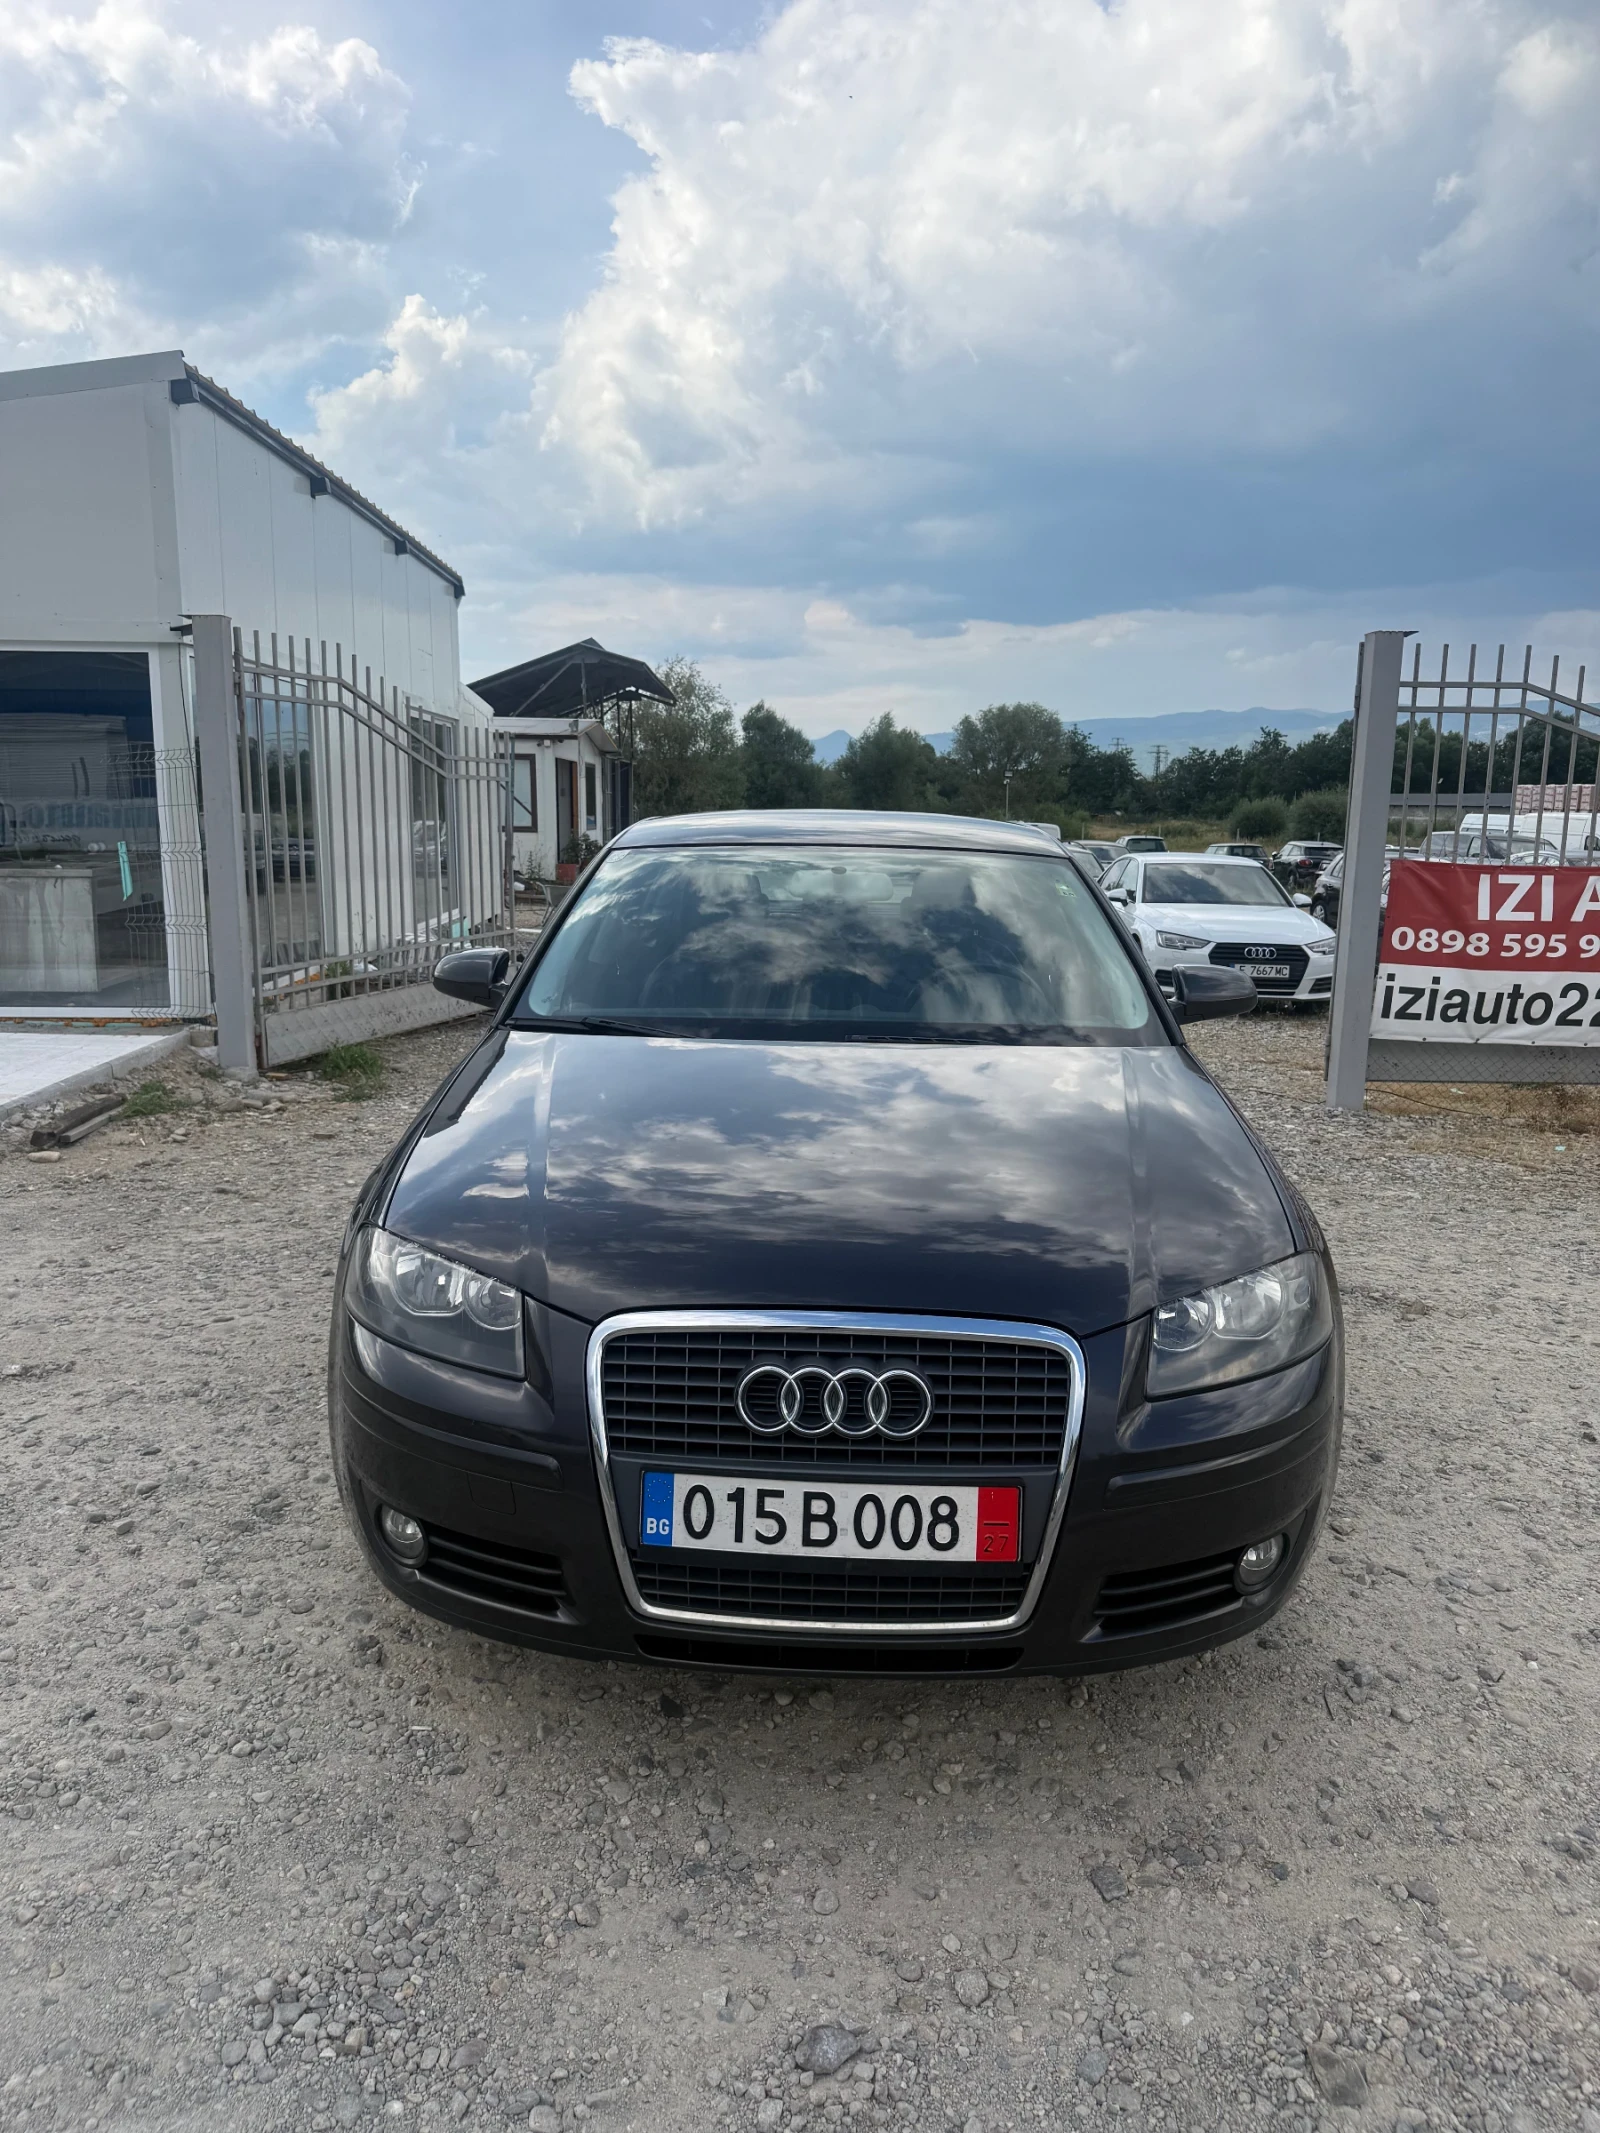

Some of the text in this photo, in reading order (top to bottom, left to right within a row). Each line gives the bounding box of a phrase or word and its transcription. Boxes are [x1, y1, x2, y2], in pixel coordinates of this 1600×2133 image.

[1477, 873, 1600, 922] IZI A
[1391, 926, 1600, 959] 0898 595 9
[646, 1517, 670, 1535] BG
[983, 1533, 1009, 1554] 27
